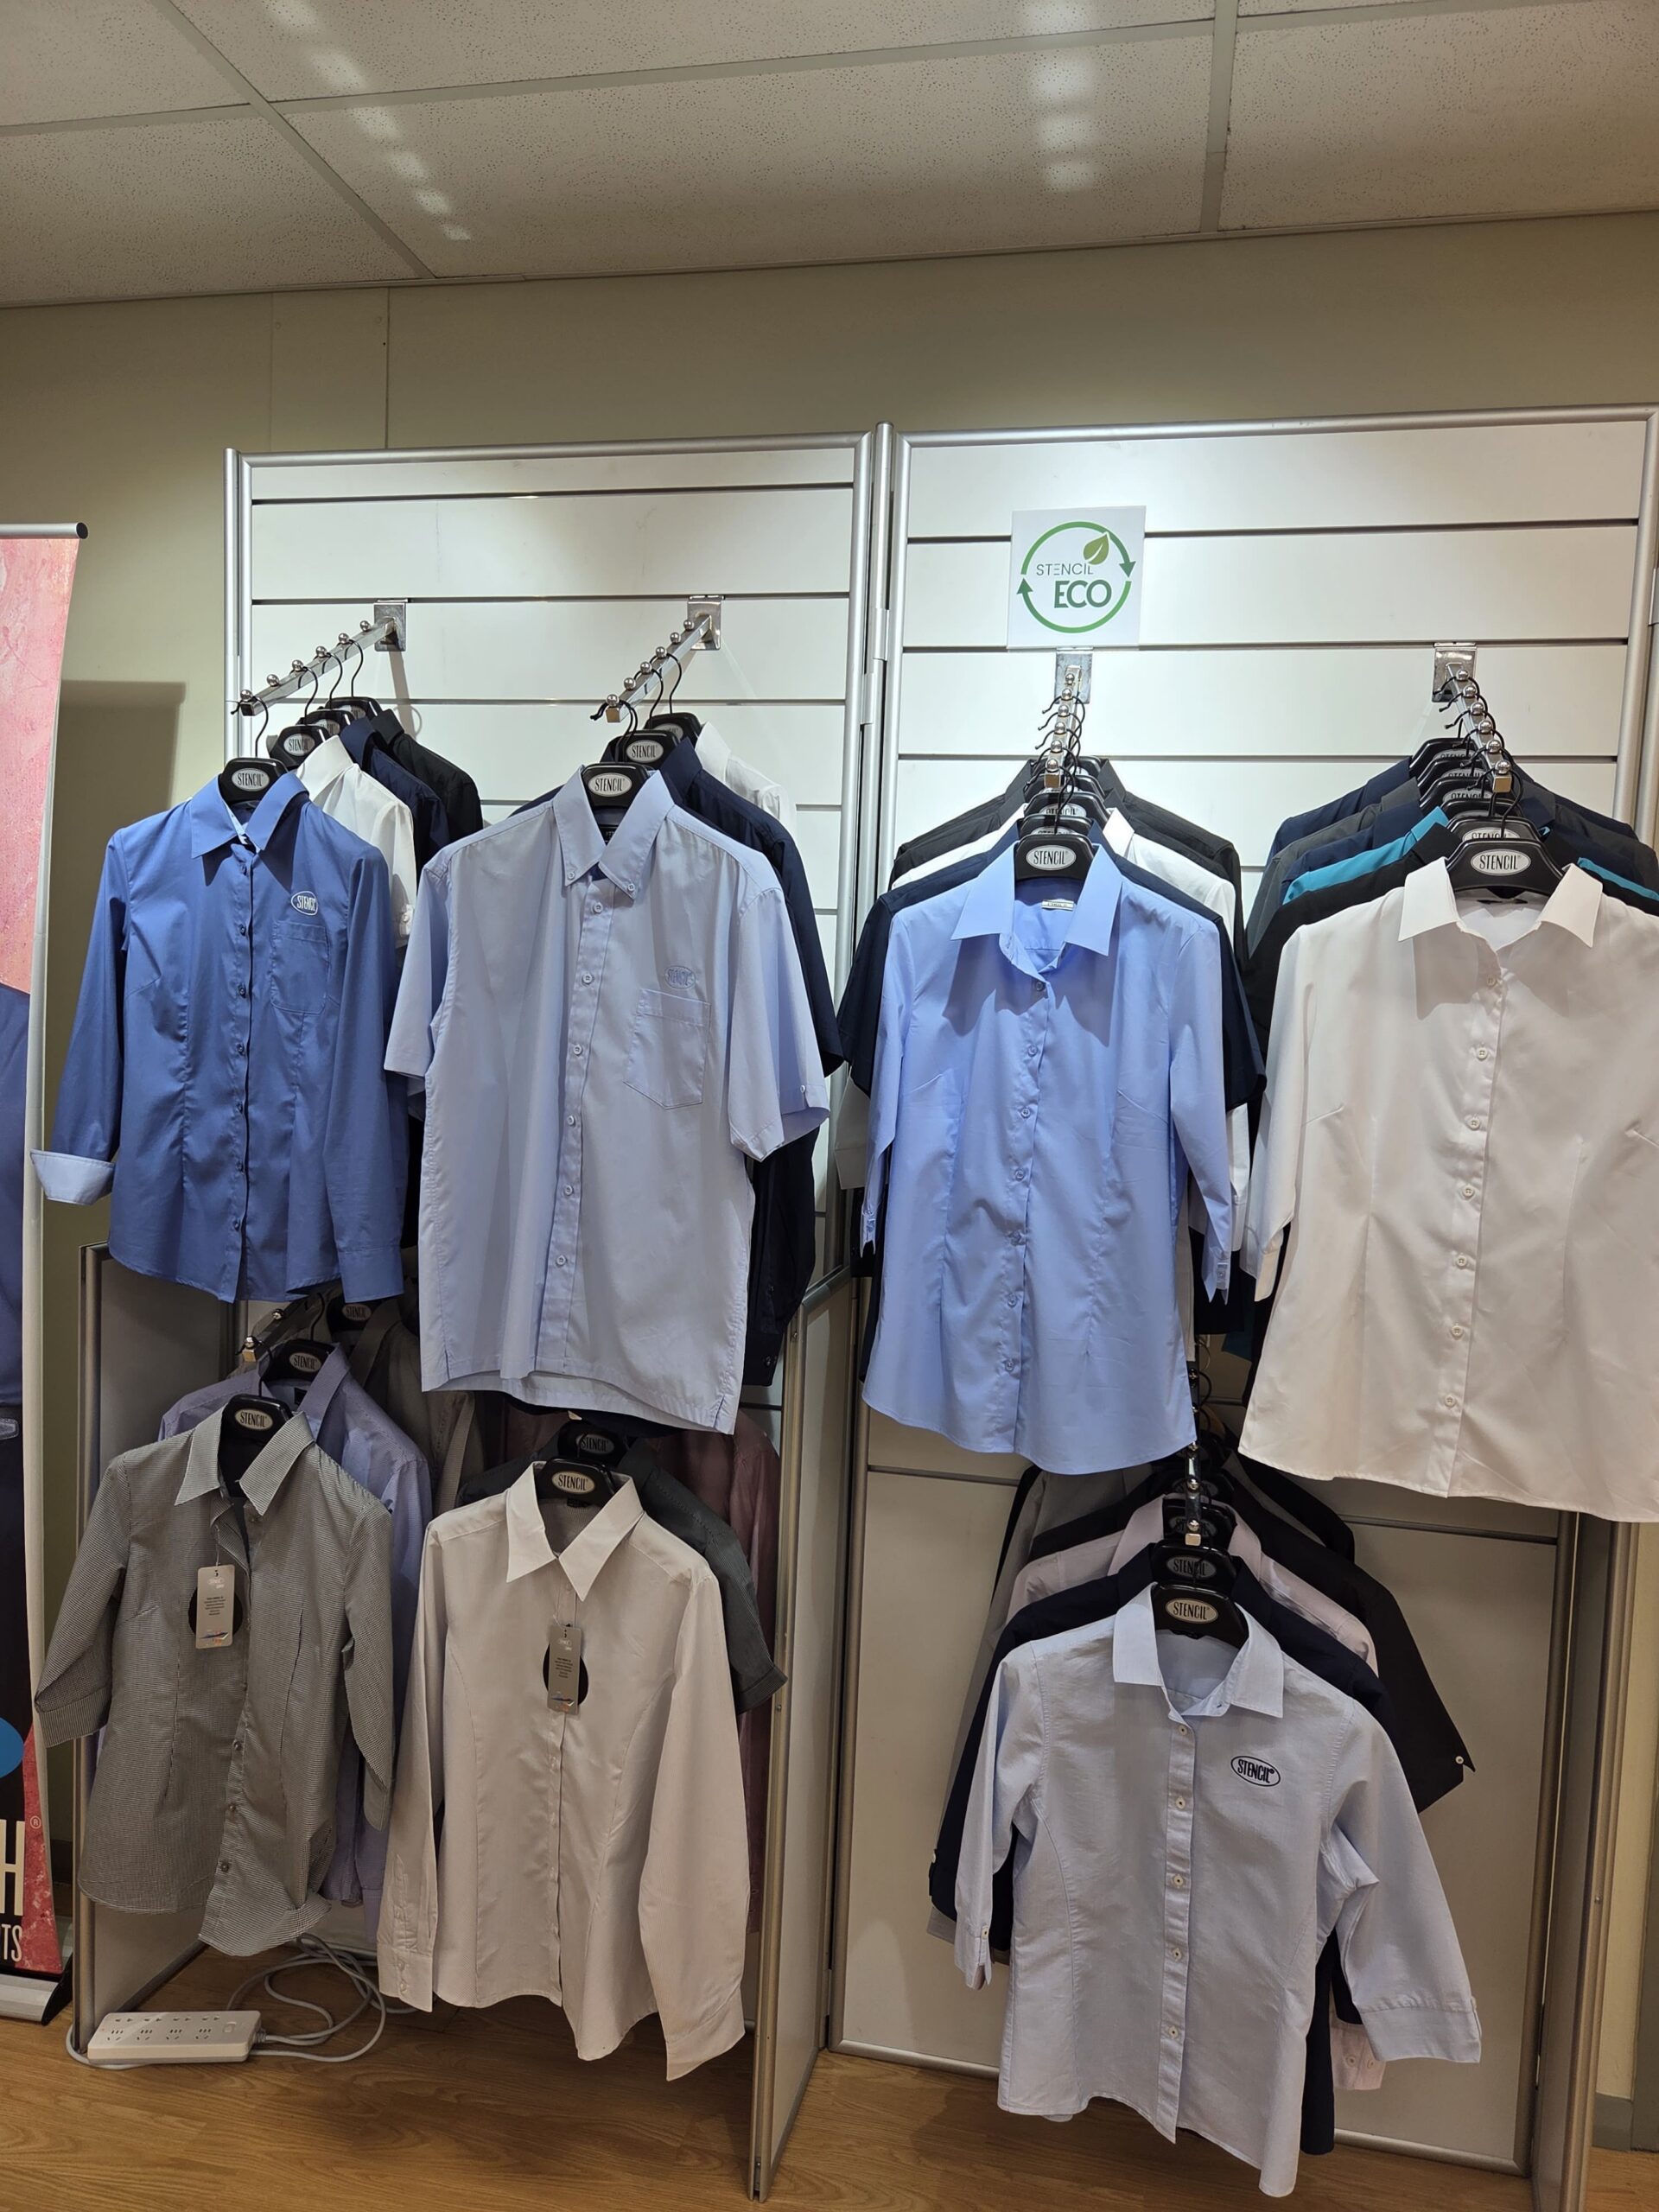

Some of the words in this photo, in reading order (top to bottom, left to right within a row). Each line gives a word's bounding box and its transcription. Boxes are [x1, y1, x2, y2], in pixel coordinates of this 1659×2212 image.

[1036, 563, 1093, 576] STENCIL
[1054, 580, 1112, 608] ECO
[632, 745, 657, 758] STENCIL
[238, 773, 264, 787] STENCIL
[594, 778, 623, 791] STENCIL
[1033, 850, 1066, 865] STENCIL
[1479, 854, 1518, 870] STENCIL
[293, 1356, 316, 1370] STENCIL
[240, 1413, 265, 1427] STENCIL
[558, 1473, 587, 1491] STENCIL
[1173, 1601, 1209, 1620] STENCIL
[1237, 1758, 1272, 1783] STENCIL
